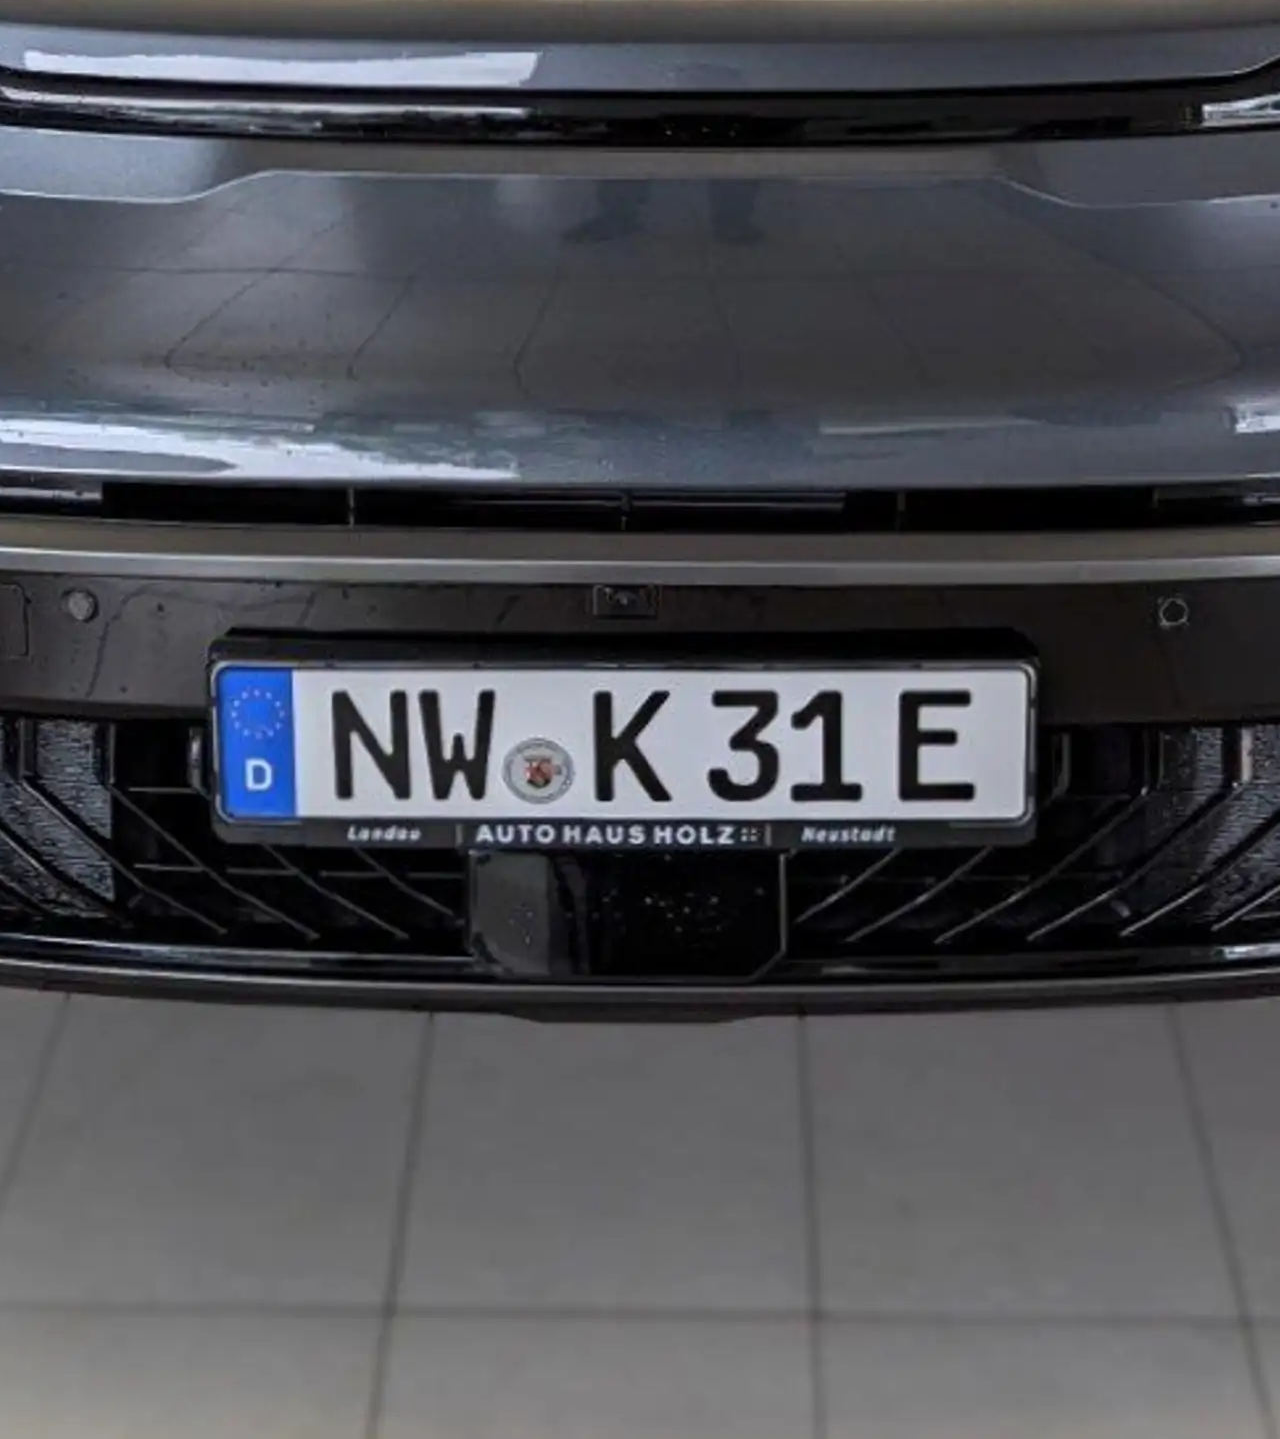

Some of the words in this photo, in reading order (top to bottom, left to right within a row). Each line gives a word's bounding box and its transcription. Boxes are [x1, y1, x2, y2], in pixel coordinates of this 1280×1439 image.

[331, 689, 496, 801] NW
[593, 689, 672, 803] K
[245, 758, 273, 791] D
[346, 824, 422, 843] Landau
[653, 824, 735, 844] HOLZ
[801, 825, 896, 844] Neustadt
